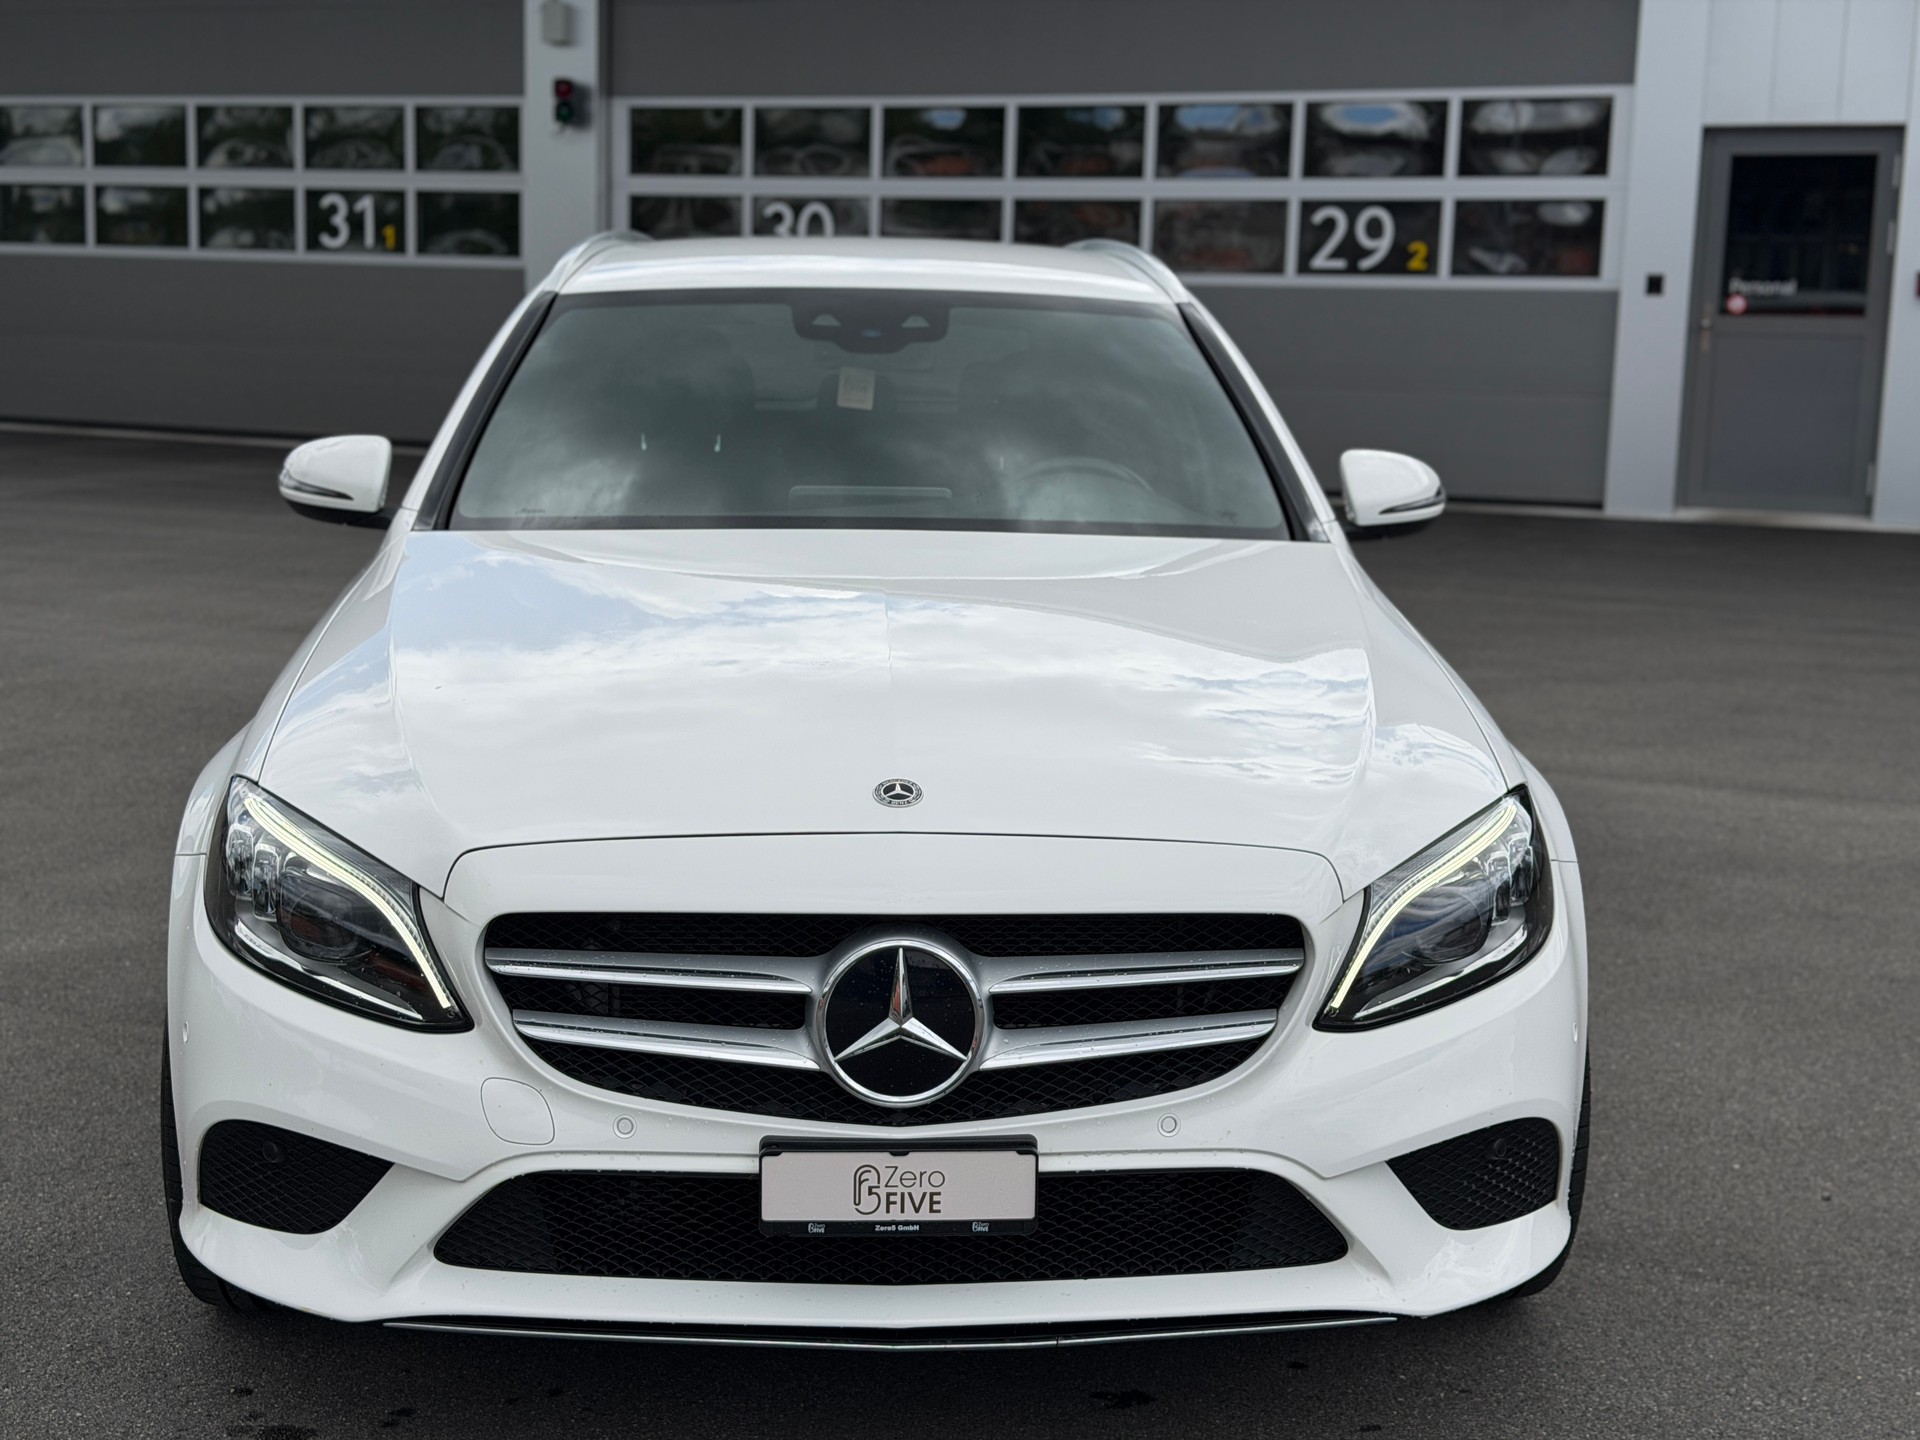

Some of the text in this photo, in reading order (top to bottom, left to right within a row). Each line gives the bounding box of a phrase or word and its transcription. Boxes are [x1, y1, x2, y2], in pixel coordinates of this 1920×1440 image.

[318, 193, 396, 250] 31 1
[1309, 205, 1428, 271] 29 2
[884, 1166, 945, 1188] Zero
[885, 1191, 942, 1214] FIVE
